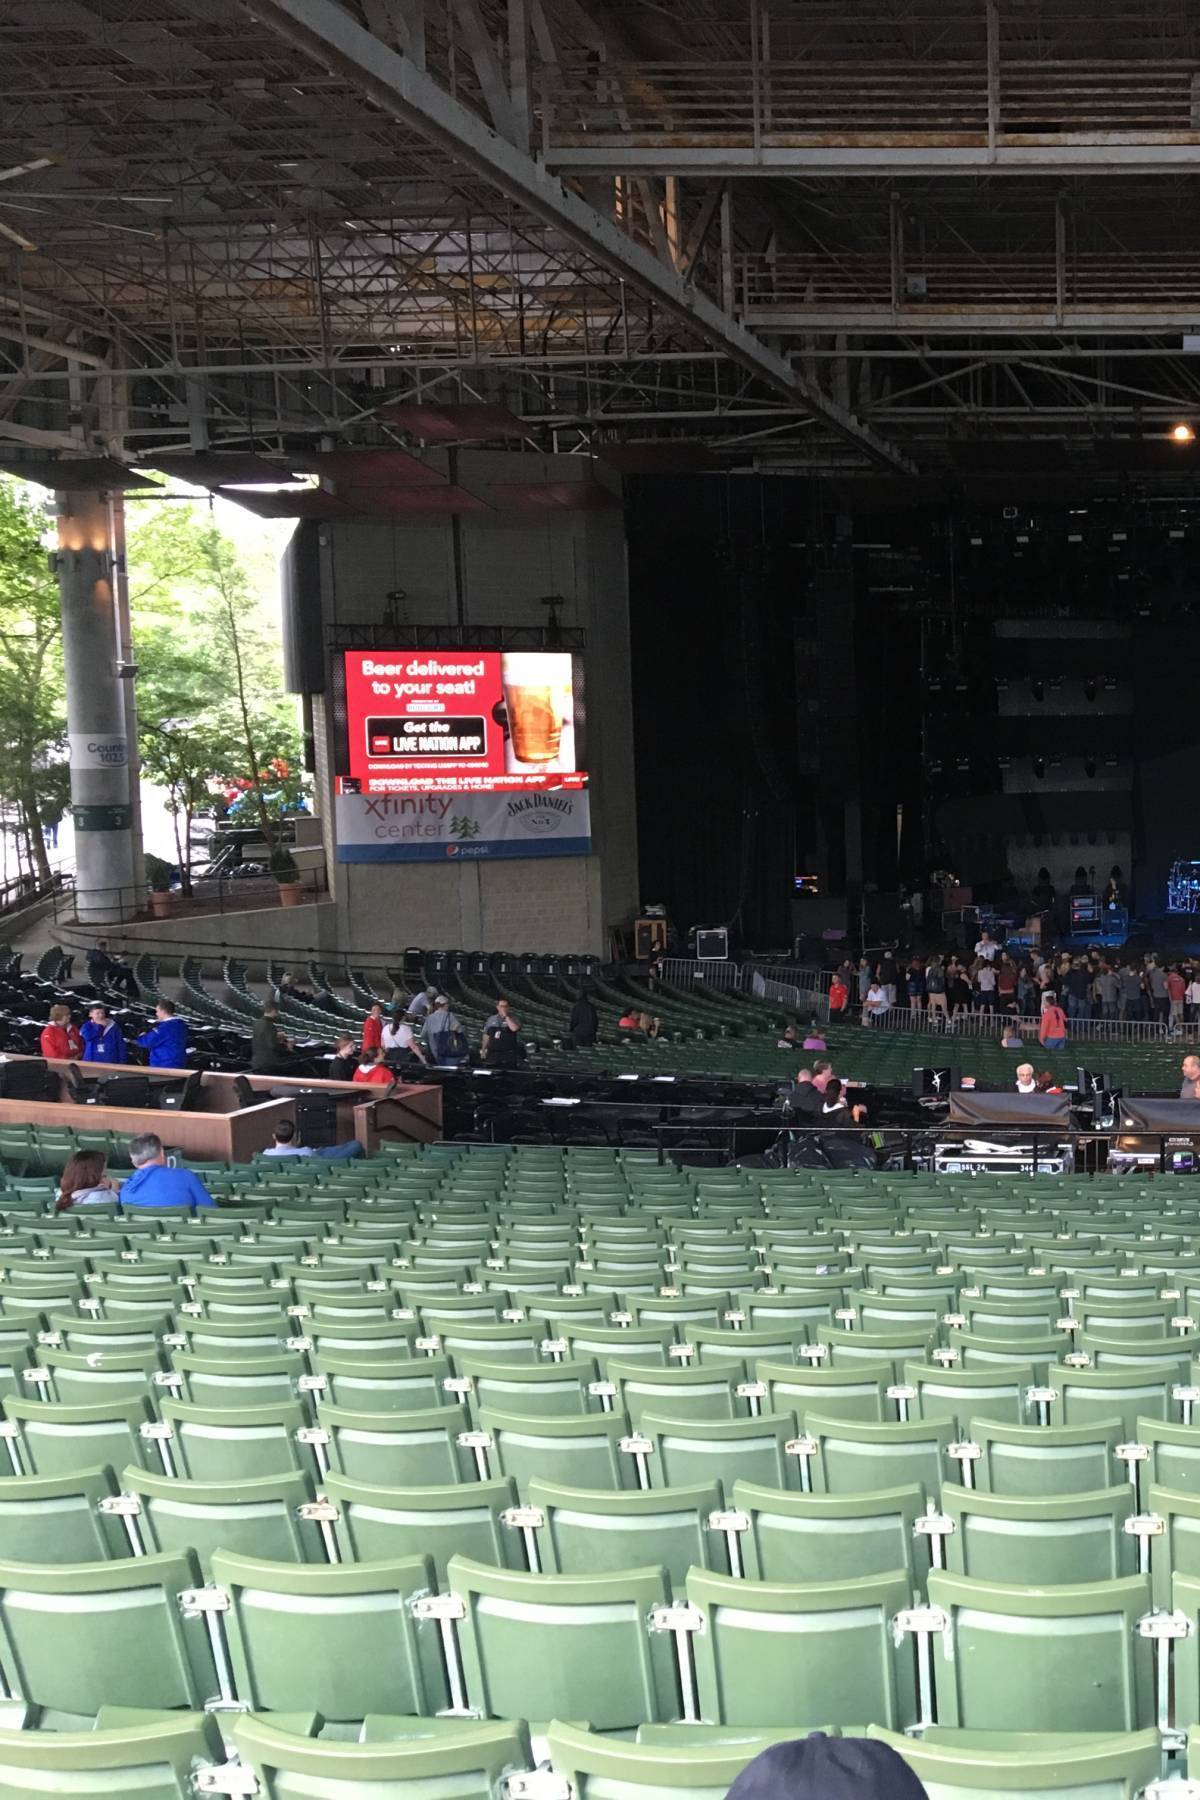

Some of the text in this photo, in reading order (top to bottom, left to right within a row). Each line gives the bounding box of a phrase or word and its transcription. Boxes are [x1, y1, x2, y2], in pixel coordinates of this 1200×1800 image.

[362, 659, 484, 676] Beer delivered
[372, 680, 475, 698] to your seat!
[403, 721, 450, 733] Get the
[393, 736, 481, 751] LIVE NATION APP
[435, 777, 457, 785] THE
[364, 792, 454, 821] xfinity
[507, 792, 574, 817] JACK DANIEL'S
[374, 820, 445, 839] center
[461, 846, 489, 857] pepsi
